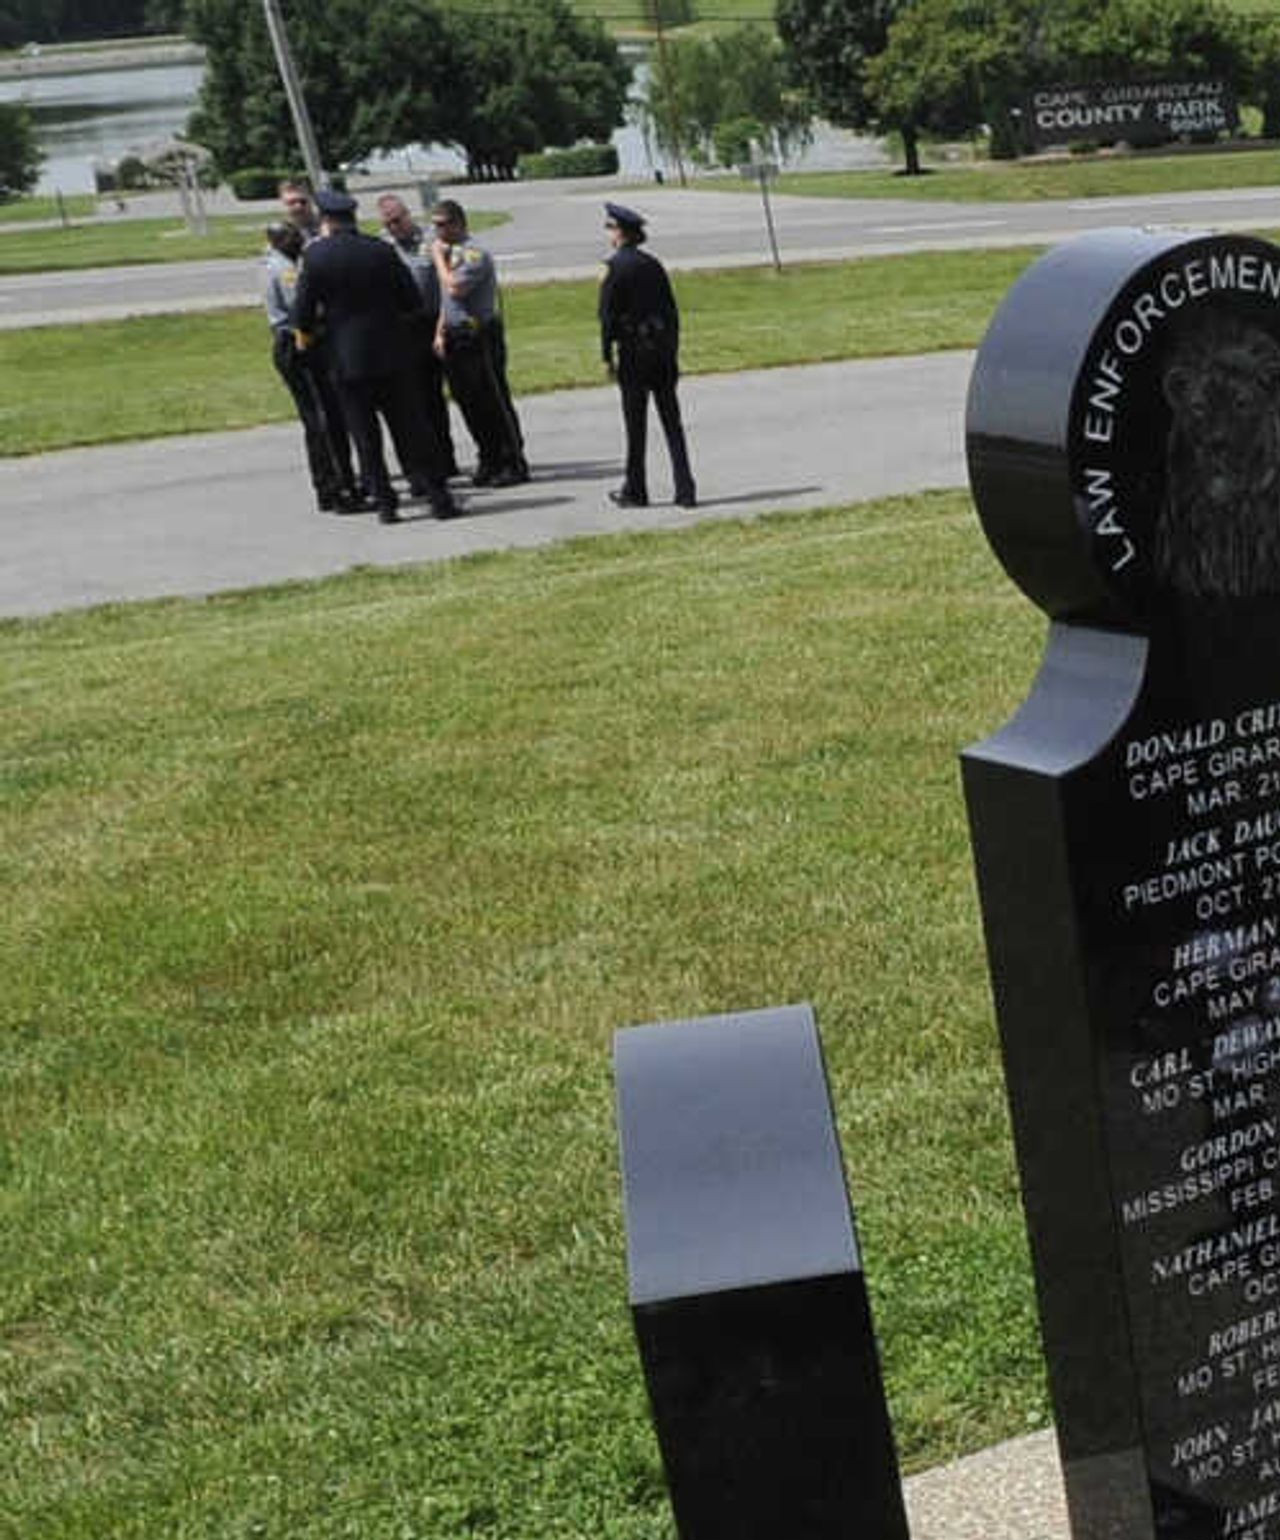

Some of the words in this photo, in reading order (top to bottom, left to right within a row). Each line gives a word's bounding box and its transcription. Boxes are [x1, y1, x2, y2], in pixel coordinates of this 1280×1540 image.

[1036, 103, 1144, 128] COUNTY
[1157, 101, 1222, 120] PARK
[1085, 467, 1135, 572] LAW
